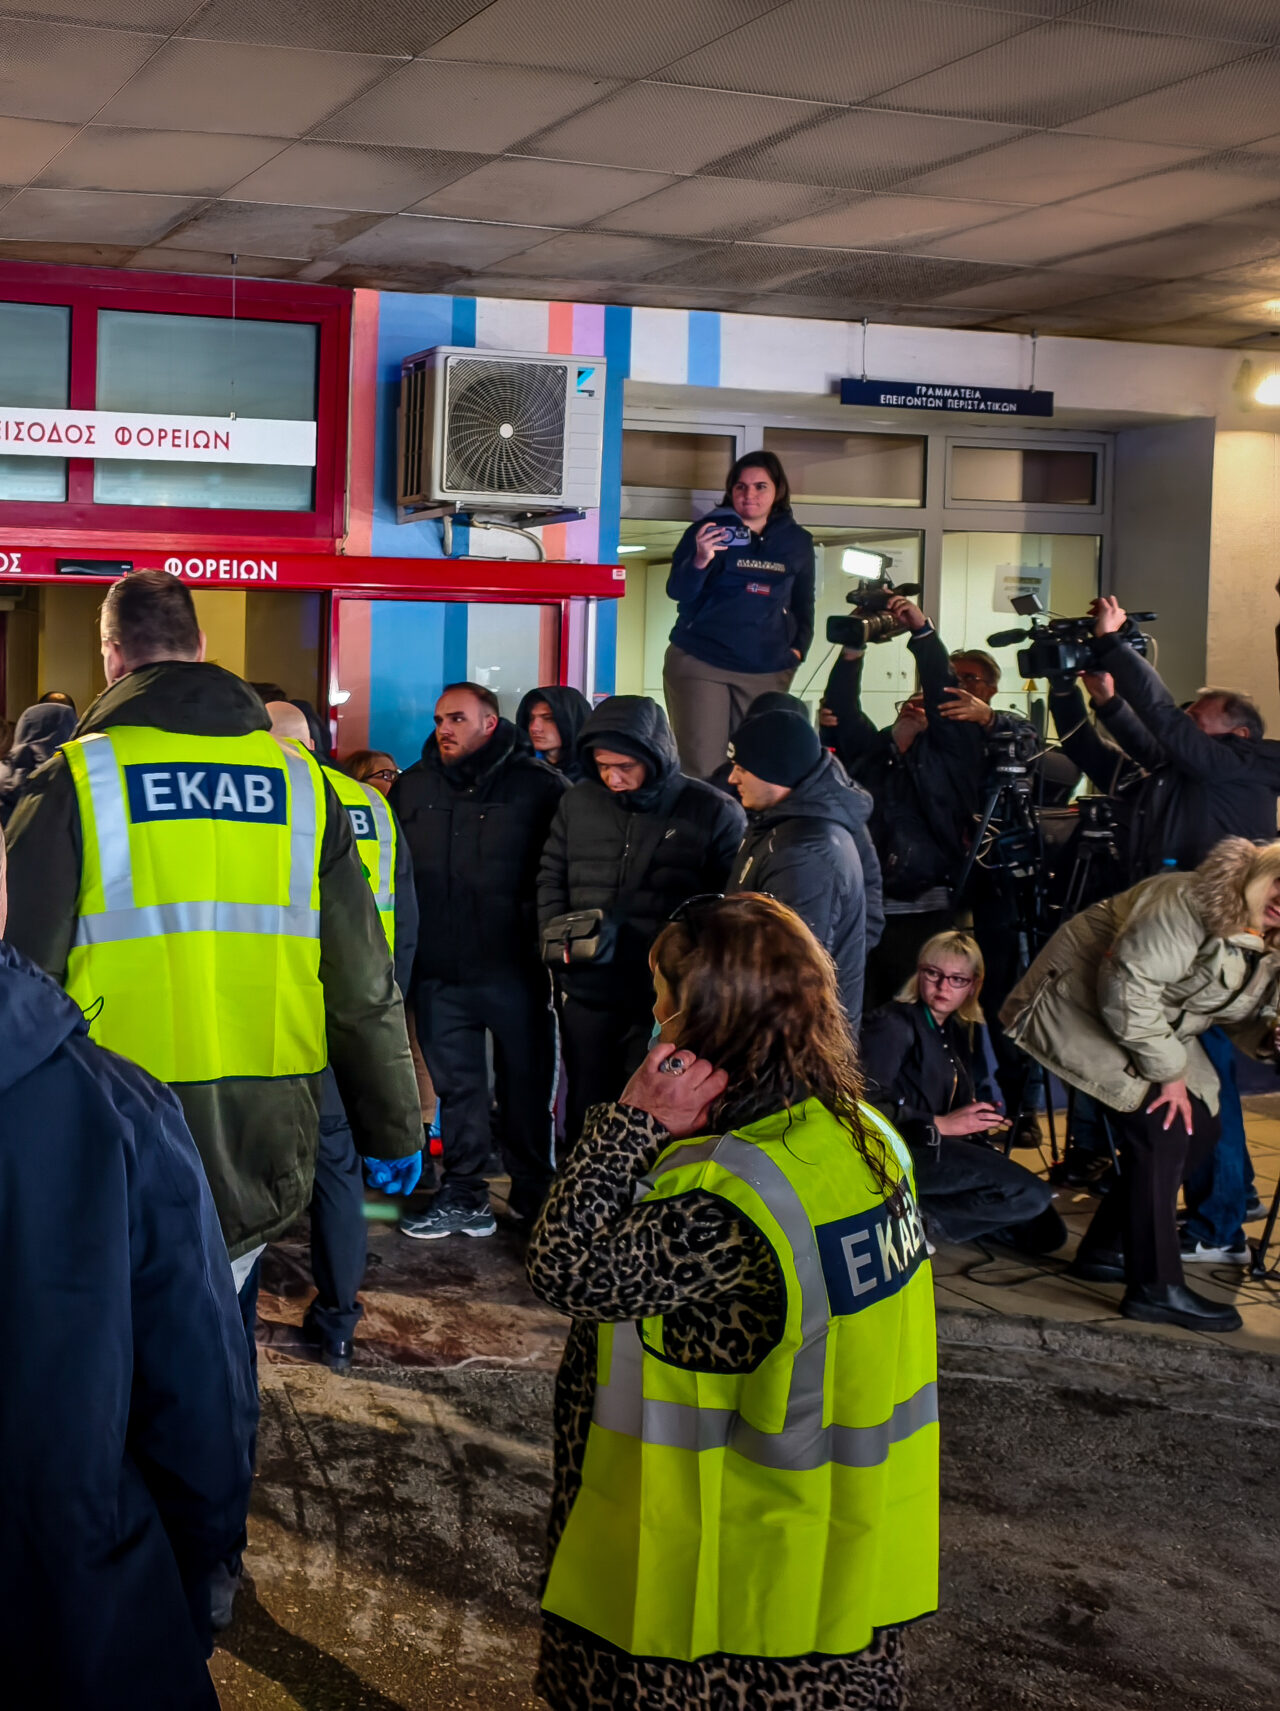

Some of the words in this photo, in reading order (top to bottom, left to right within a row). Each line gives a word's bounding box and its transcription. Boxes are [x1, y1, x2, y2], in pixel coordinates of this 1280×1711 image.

[880, 394, 943, 408] ΕΠΕΙΓΟΝΤΩΝ
[947, 399, 1017, 412] ΠΕΡΙΣΤΑΤΙΚΩΝ
[916, 385, 982, 399] ΓΡΑΜΜΑΤΕΙΑ
[115, 425, 231, 451] ΦΟΡΕΙΩΝ
[163, 557, 278, 581] ΦΟΡΕΙΩΝ
[141, 771, 275, 814] ΕΚΑΒ
